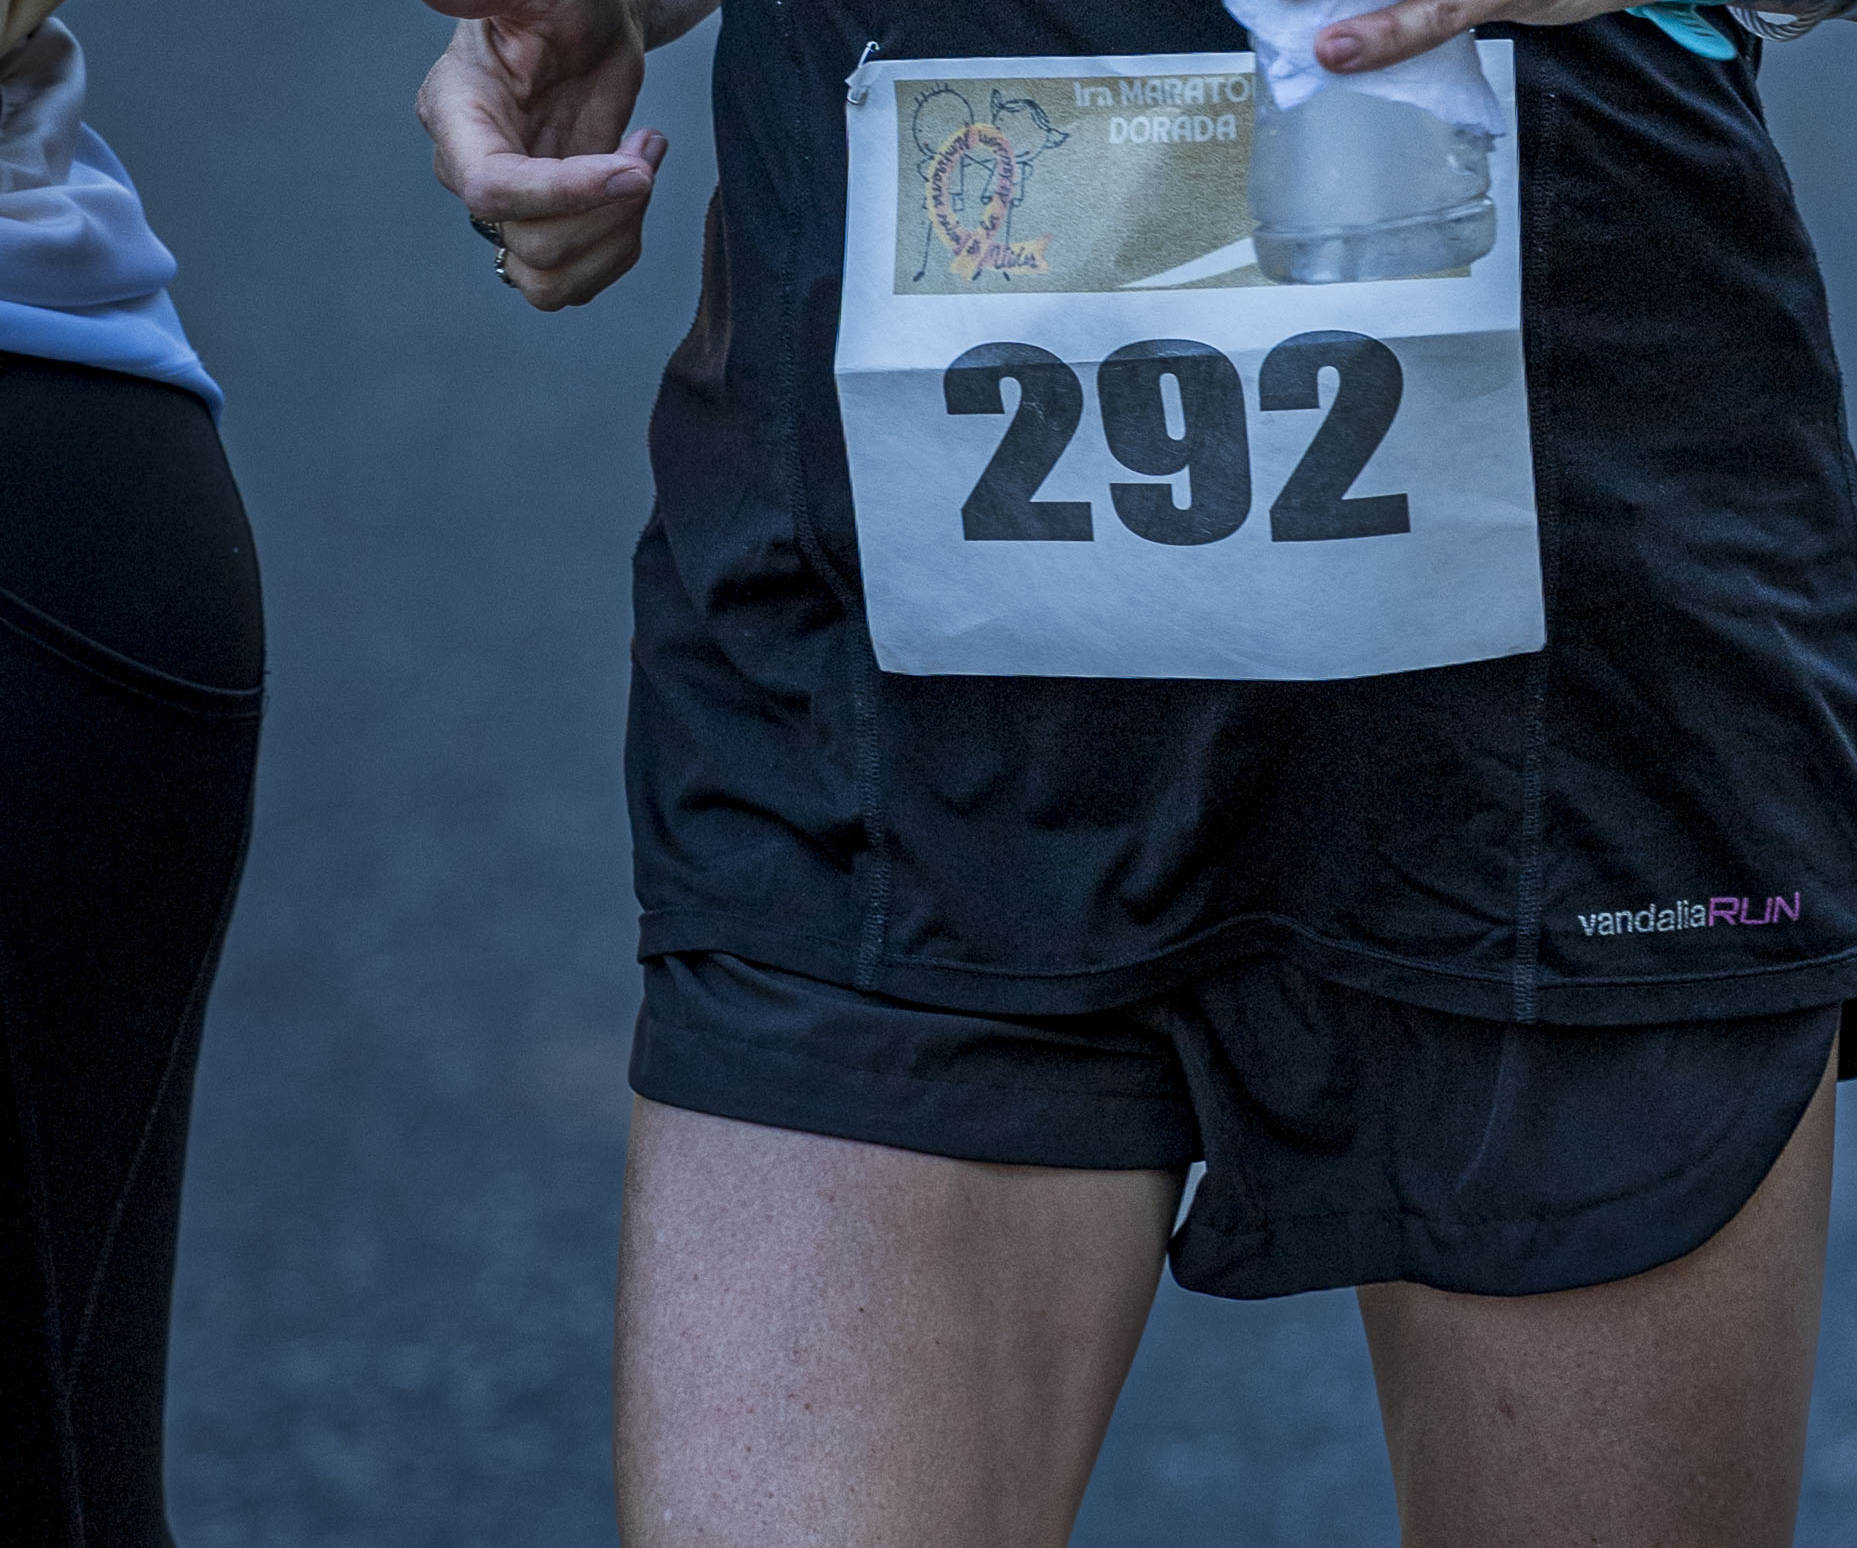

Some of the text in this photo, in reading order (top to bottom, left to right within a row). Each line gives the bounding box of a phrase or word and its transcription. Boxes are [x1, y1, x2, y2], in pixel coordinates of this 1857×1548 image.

[1118, 76, 1256, 107] MARATO
[1108, 113, 1238, 145] DORADA
[943, 329, 1412, 547] 292
[1577, 891, 1800, 937] vandaliaRUN
